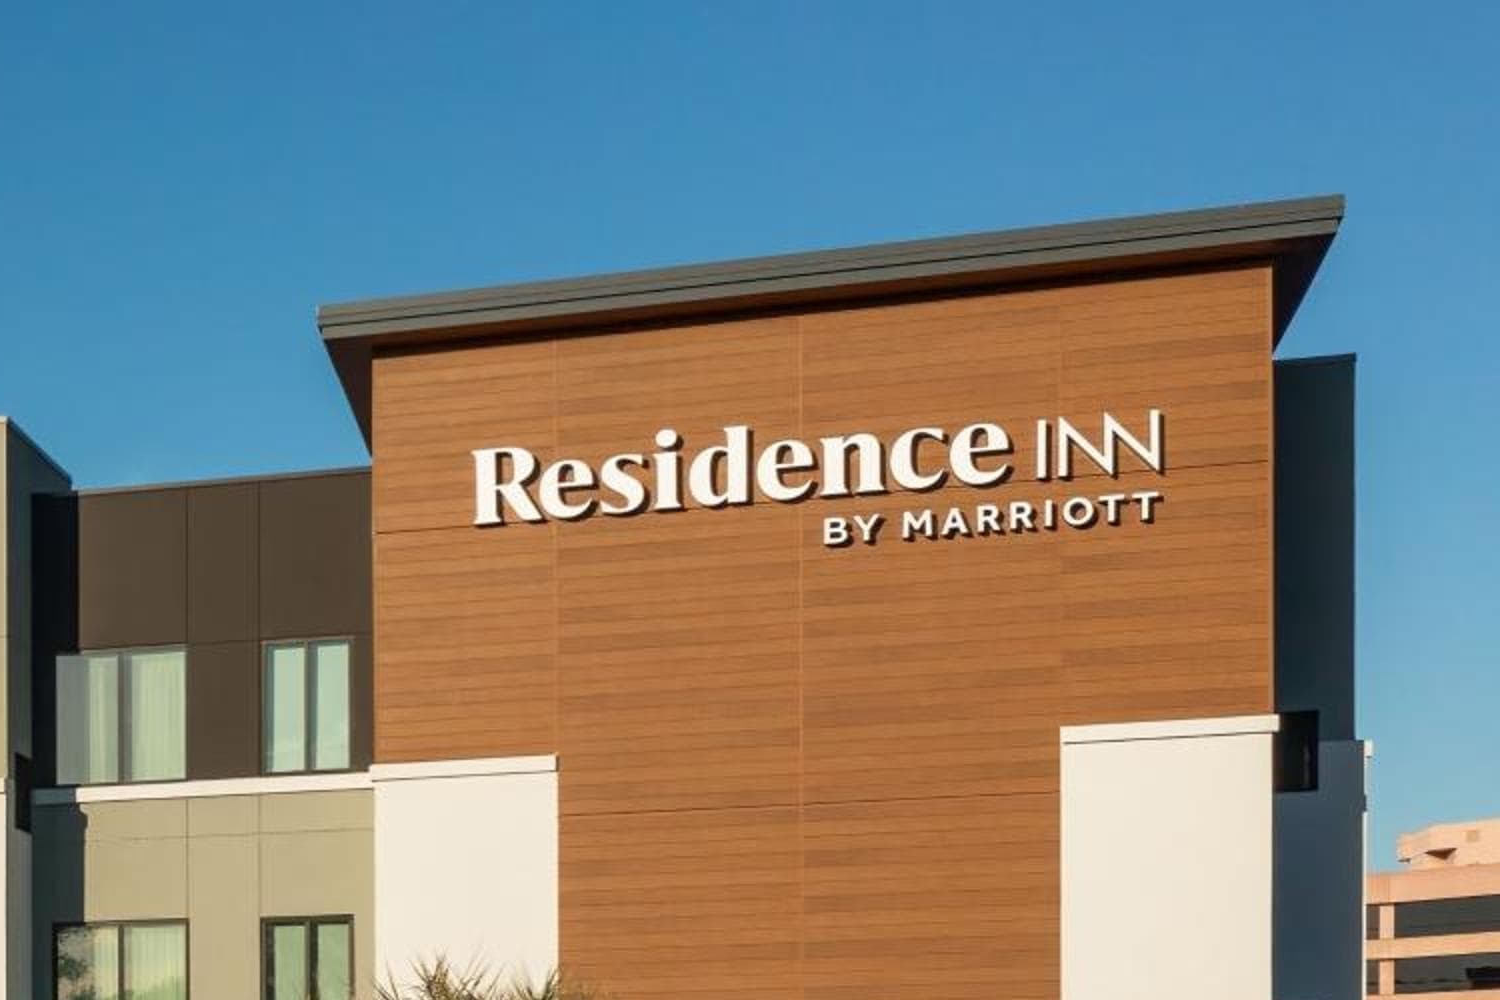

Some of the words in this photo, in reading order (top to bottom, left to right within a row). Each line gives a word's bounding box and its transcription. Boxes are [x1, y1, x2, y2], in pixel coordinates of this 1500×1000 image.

[471, 423, 1010, 524] Residence
[1036, 409, 1161, 478] INN
[823, 513, 880, 545] BY
[902, 491, 1160, 538] MARRIOTT
